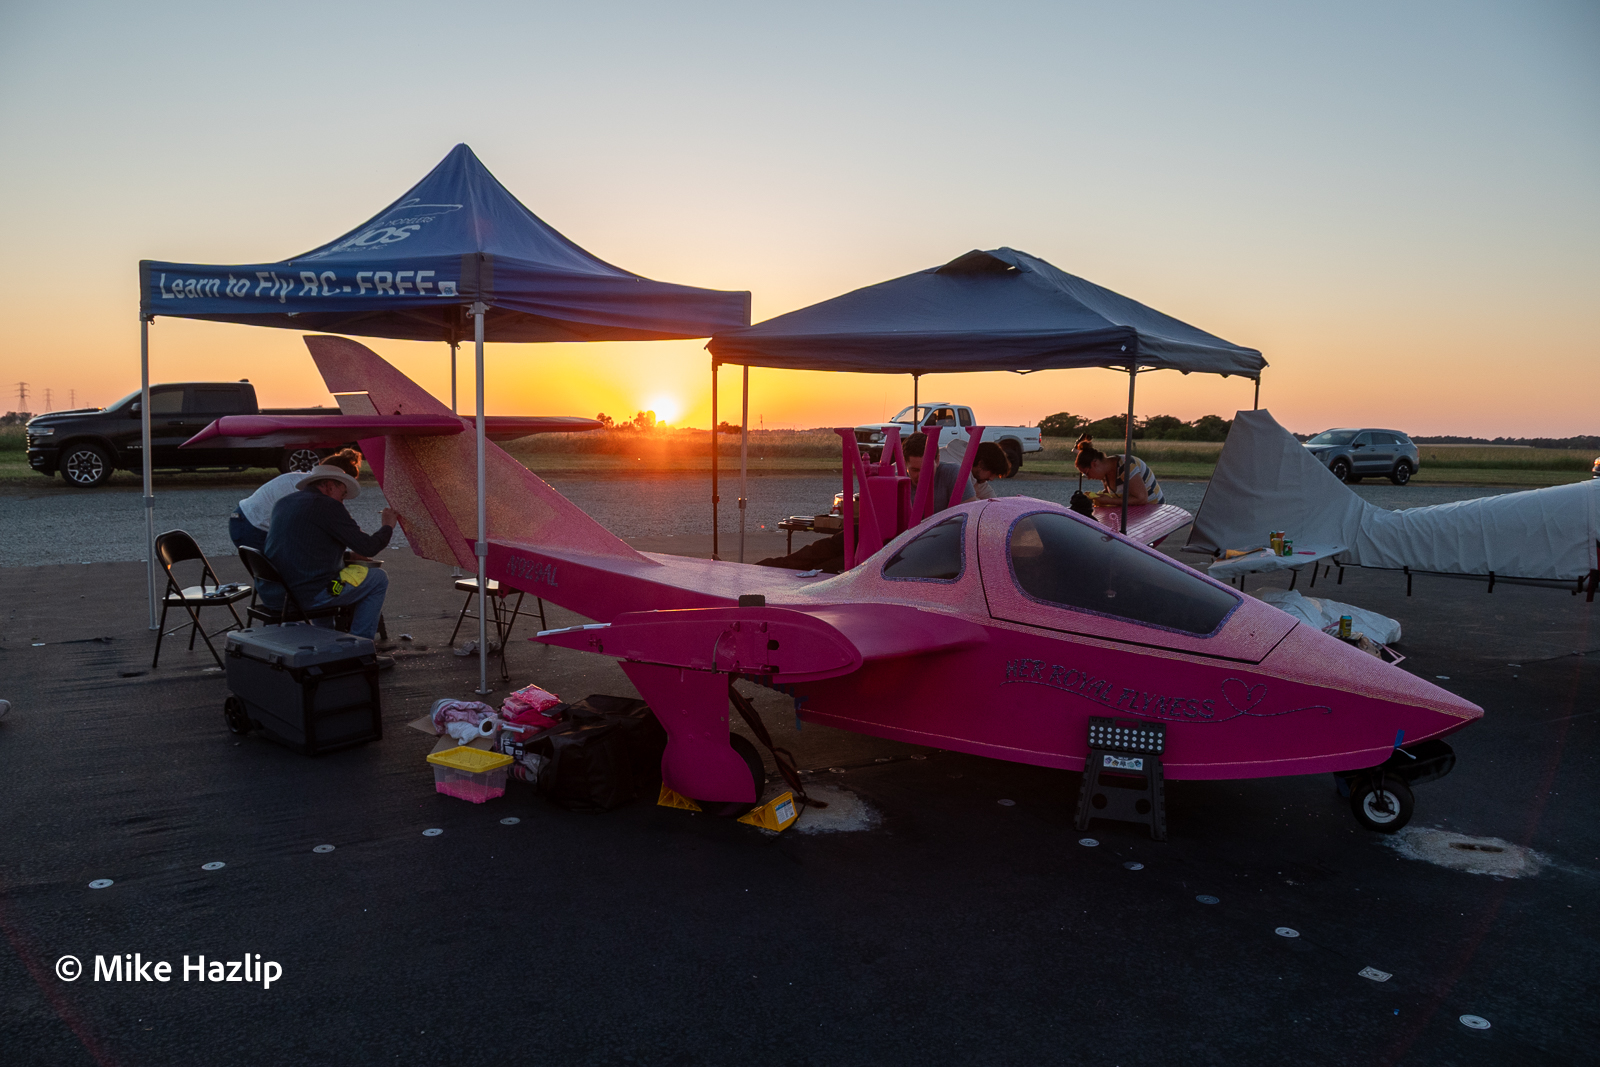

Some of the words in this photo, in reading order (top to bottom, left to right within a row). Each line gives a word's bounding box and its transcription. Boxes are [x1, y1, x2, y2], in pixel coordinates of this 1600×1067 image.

[159, 273, 221, 299] Learn
[228, 273, 250, 298] to
[254, 271, 295, 303] Fly
[1006, 658, 1047, 680] HER
[1049, 663, 1113, 701] ROYAL
[1116, 687, 1216, 719] FLYNESS
